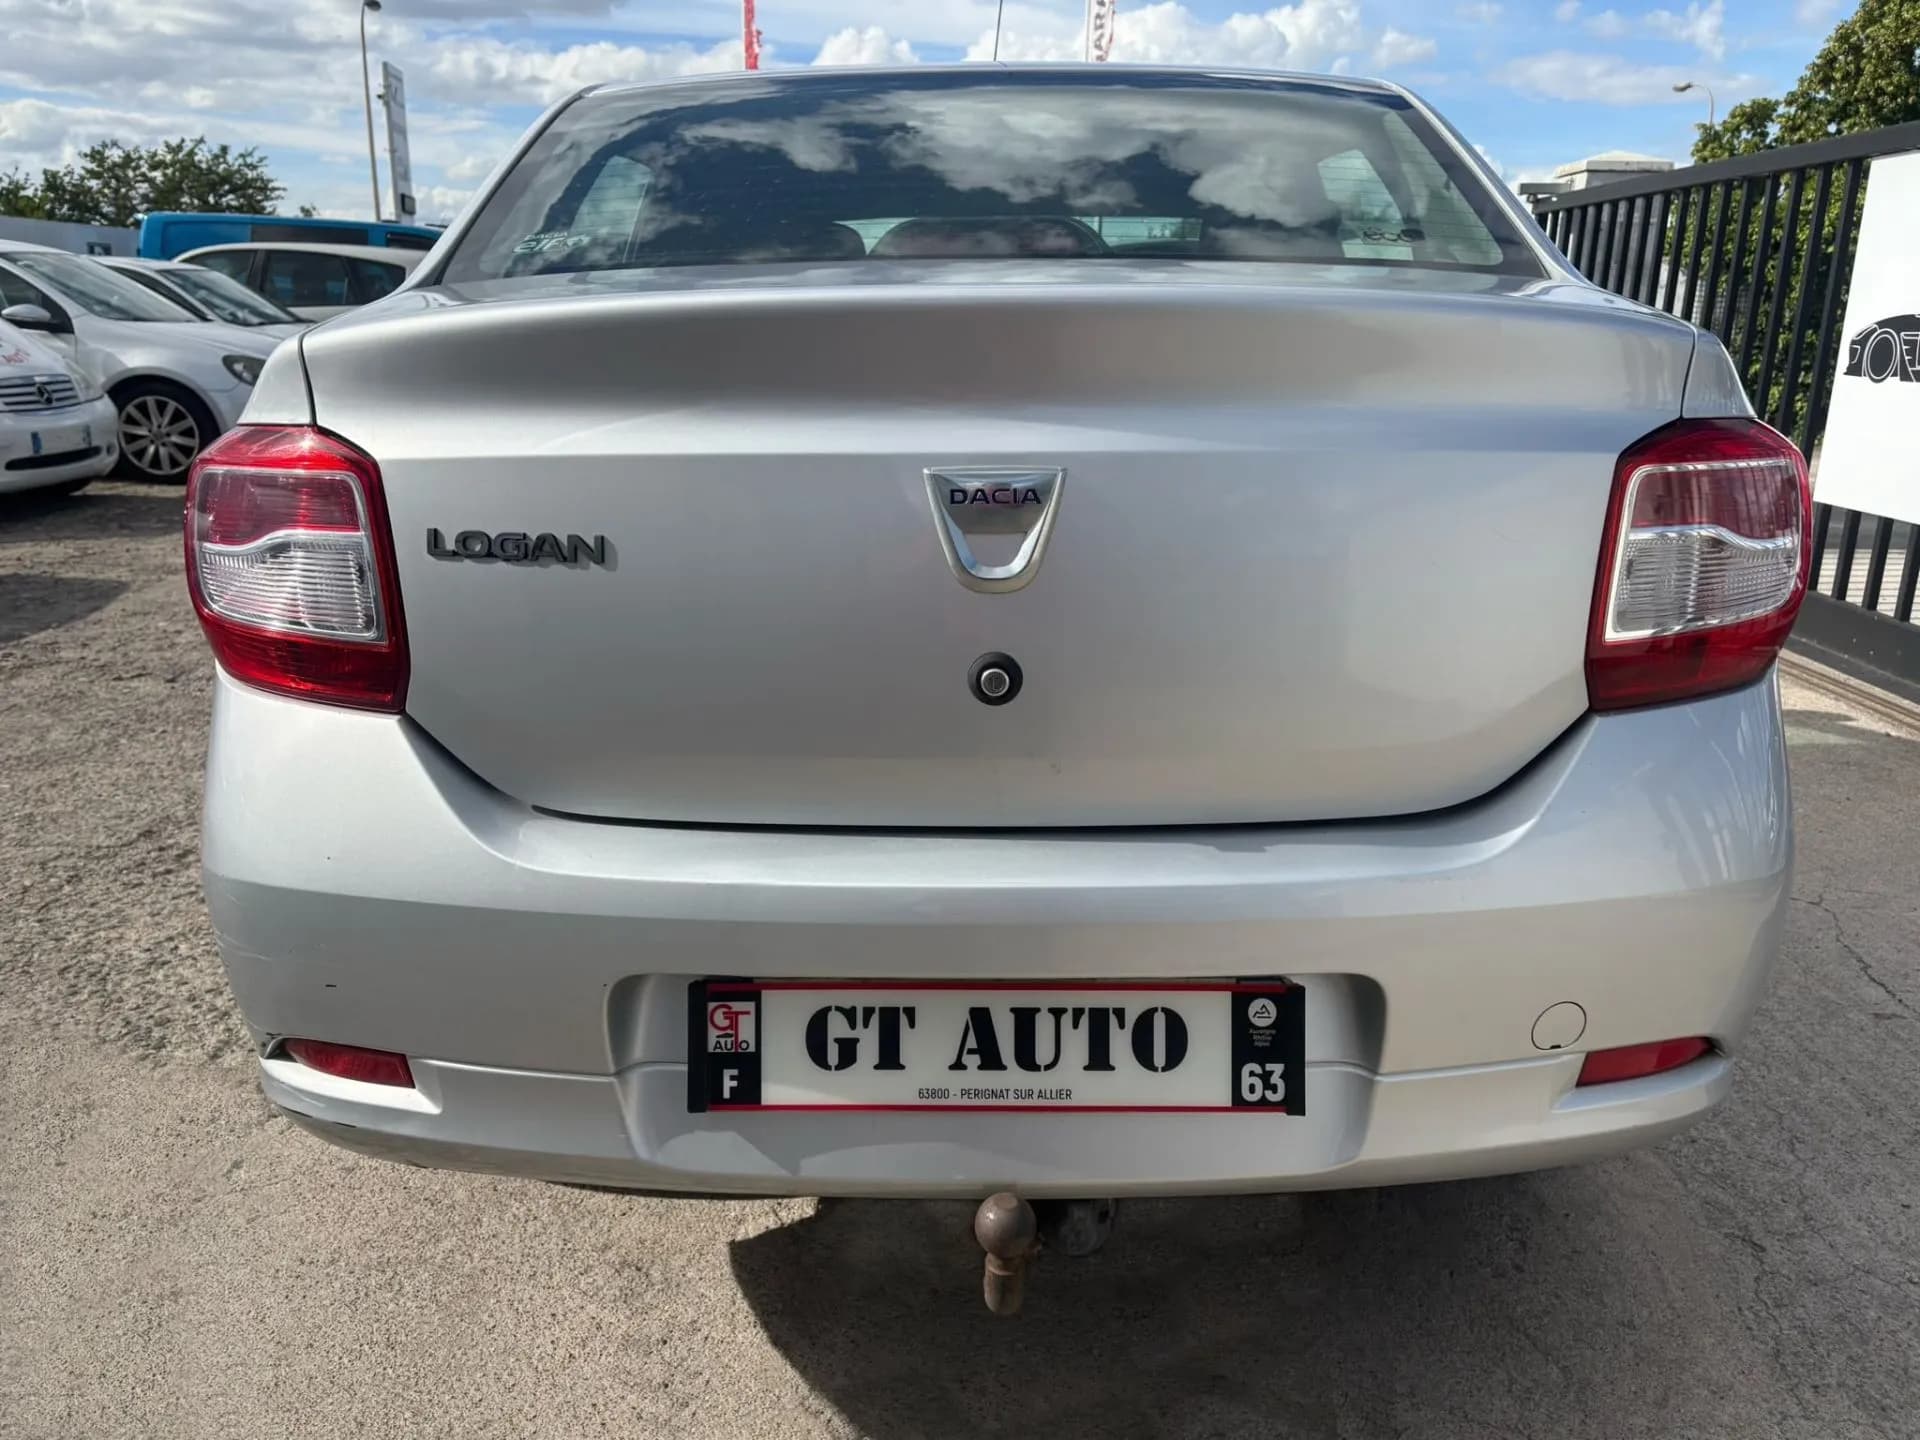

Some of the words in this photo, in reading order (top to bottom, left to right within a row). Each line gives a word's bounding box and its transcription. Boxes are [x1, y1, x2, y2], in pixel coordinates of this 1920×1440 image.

[949, 488, 1042, 505] DACIA
[426, 527, 606, 565] LOGAN
[804, 1004, 917, 1072] GT
[947, 1006, 1190, 1073] AUTO
[722, 1068, 739, 1100] F
[918, 1087, 950, 1100] 63800
[960, 1088, 1010, 1100] PERIGNAT
[1013, 1088, 1034, 1100] SUR
[1037, 1088, 1072, 1100] ALLIER
[1240, 1062, 1286, 1102] 63
